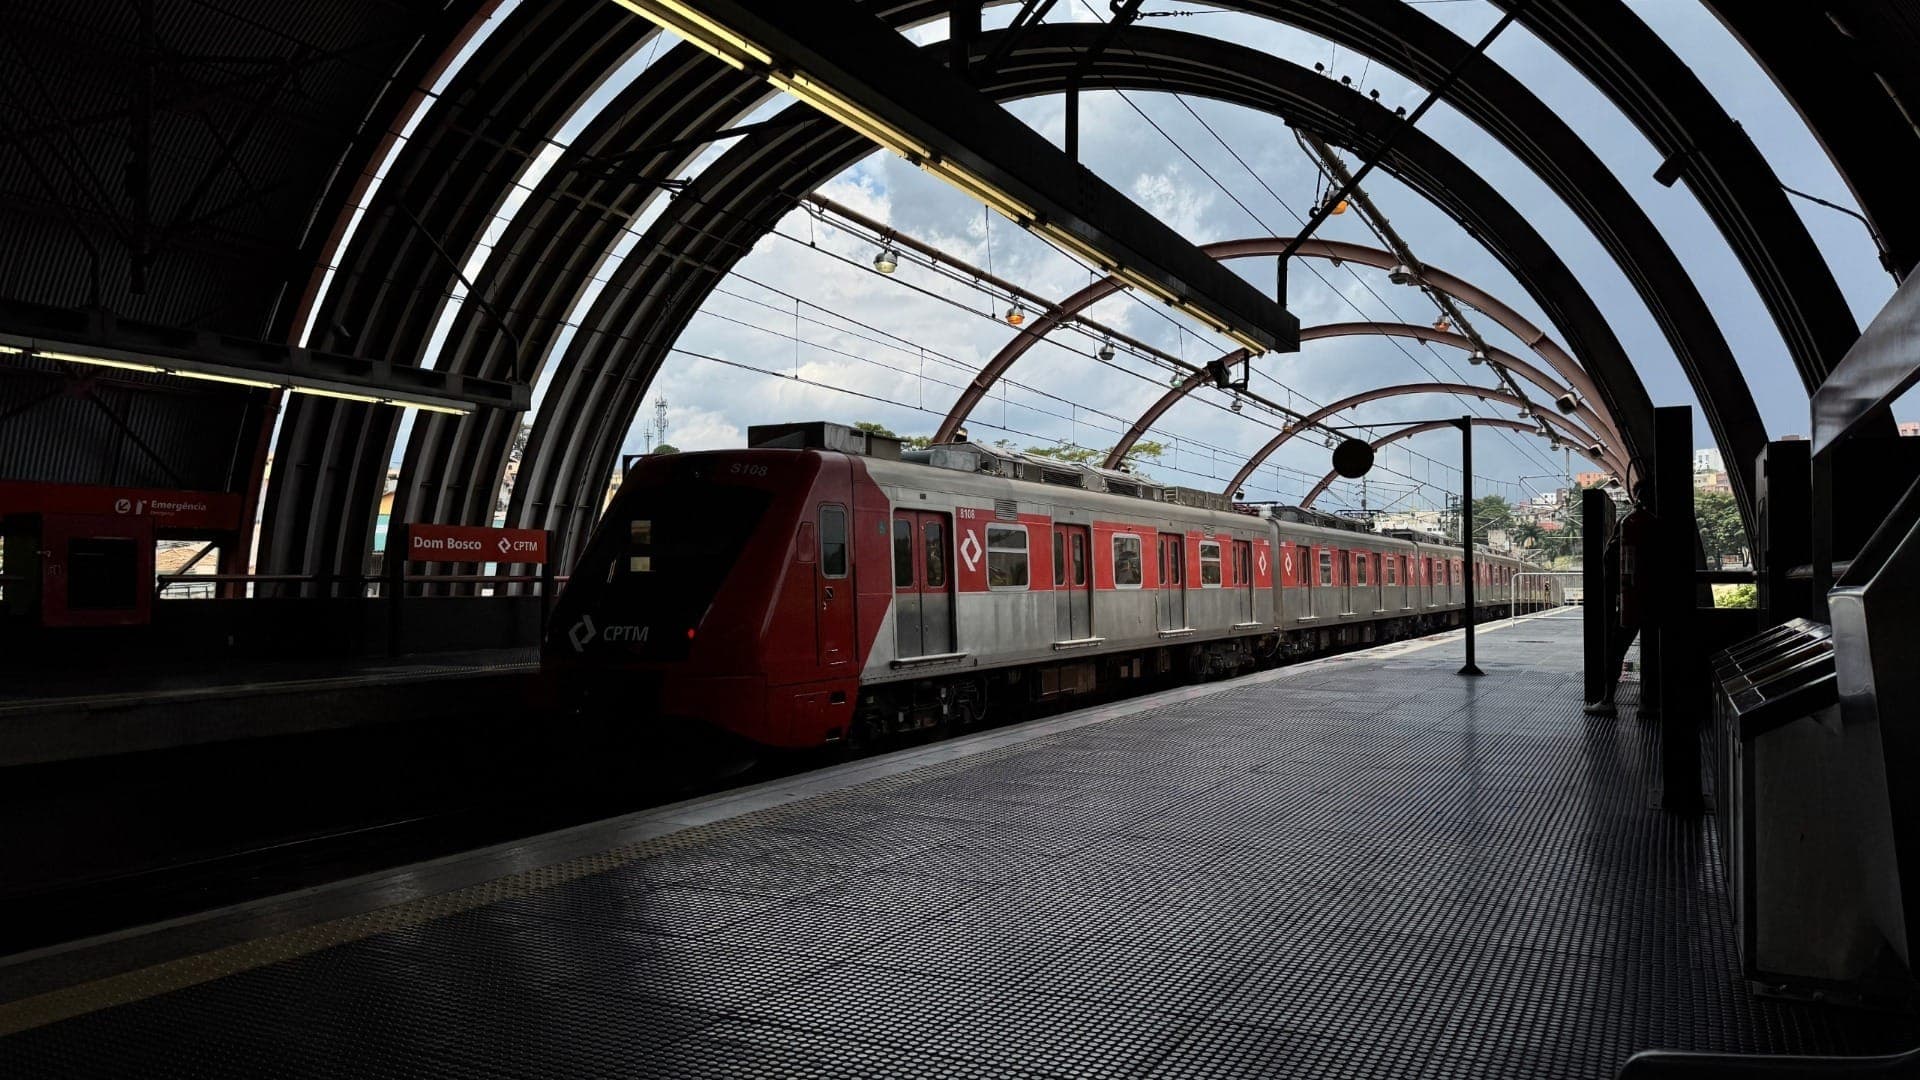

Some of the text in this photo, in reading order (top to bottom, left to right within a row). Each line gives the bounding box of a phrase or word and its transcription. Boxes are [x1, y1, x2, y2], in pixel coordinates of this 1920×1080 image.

[151, 500, 207, 512] Emergência
[413, 536, 538, 552] Dom Bosco CPTM
[603, 625, 649, 642] CPTM
